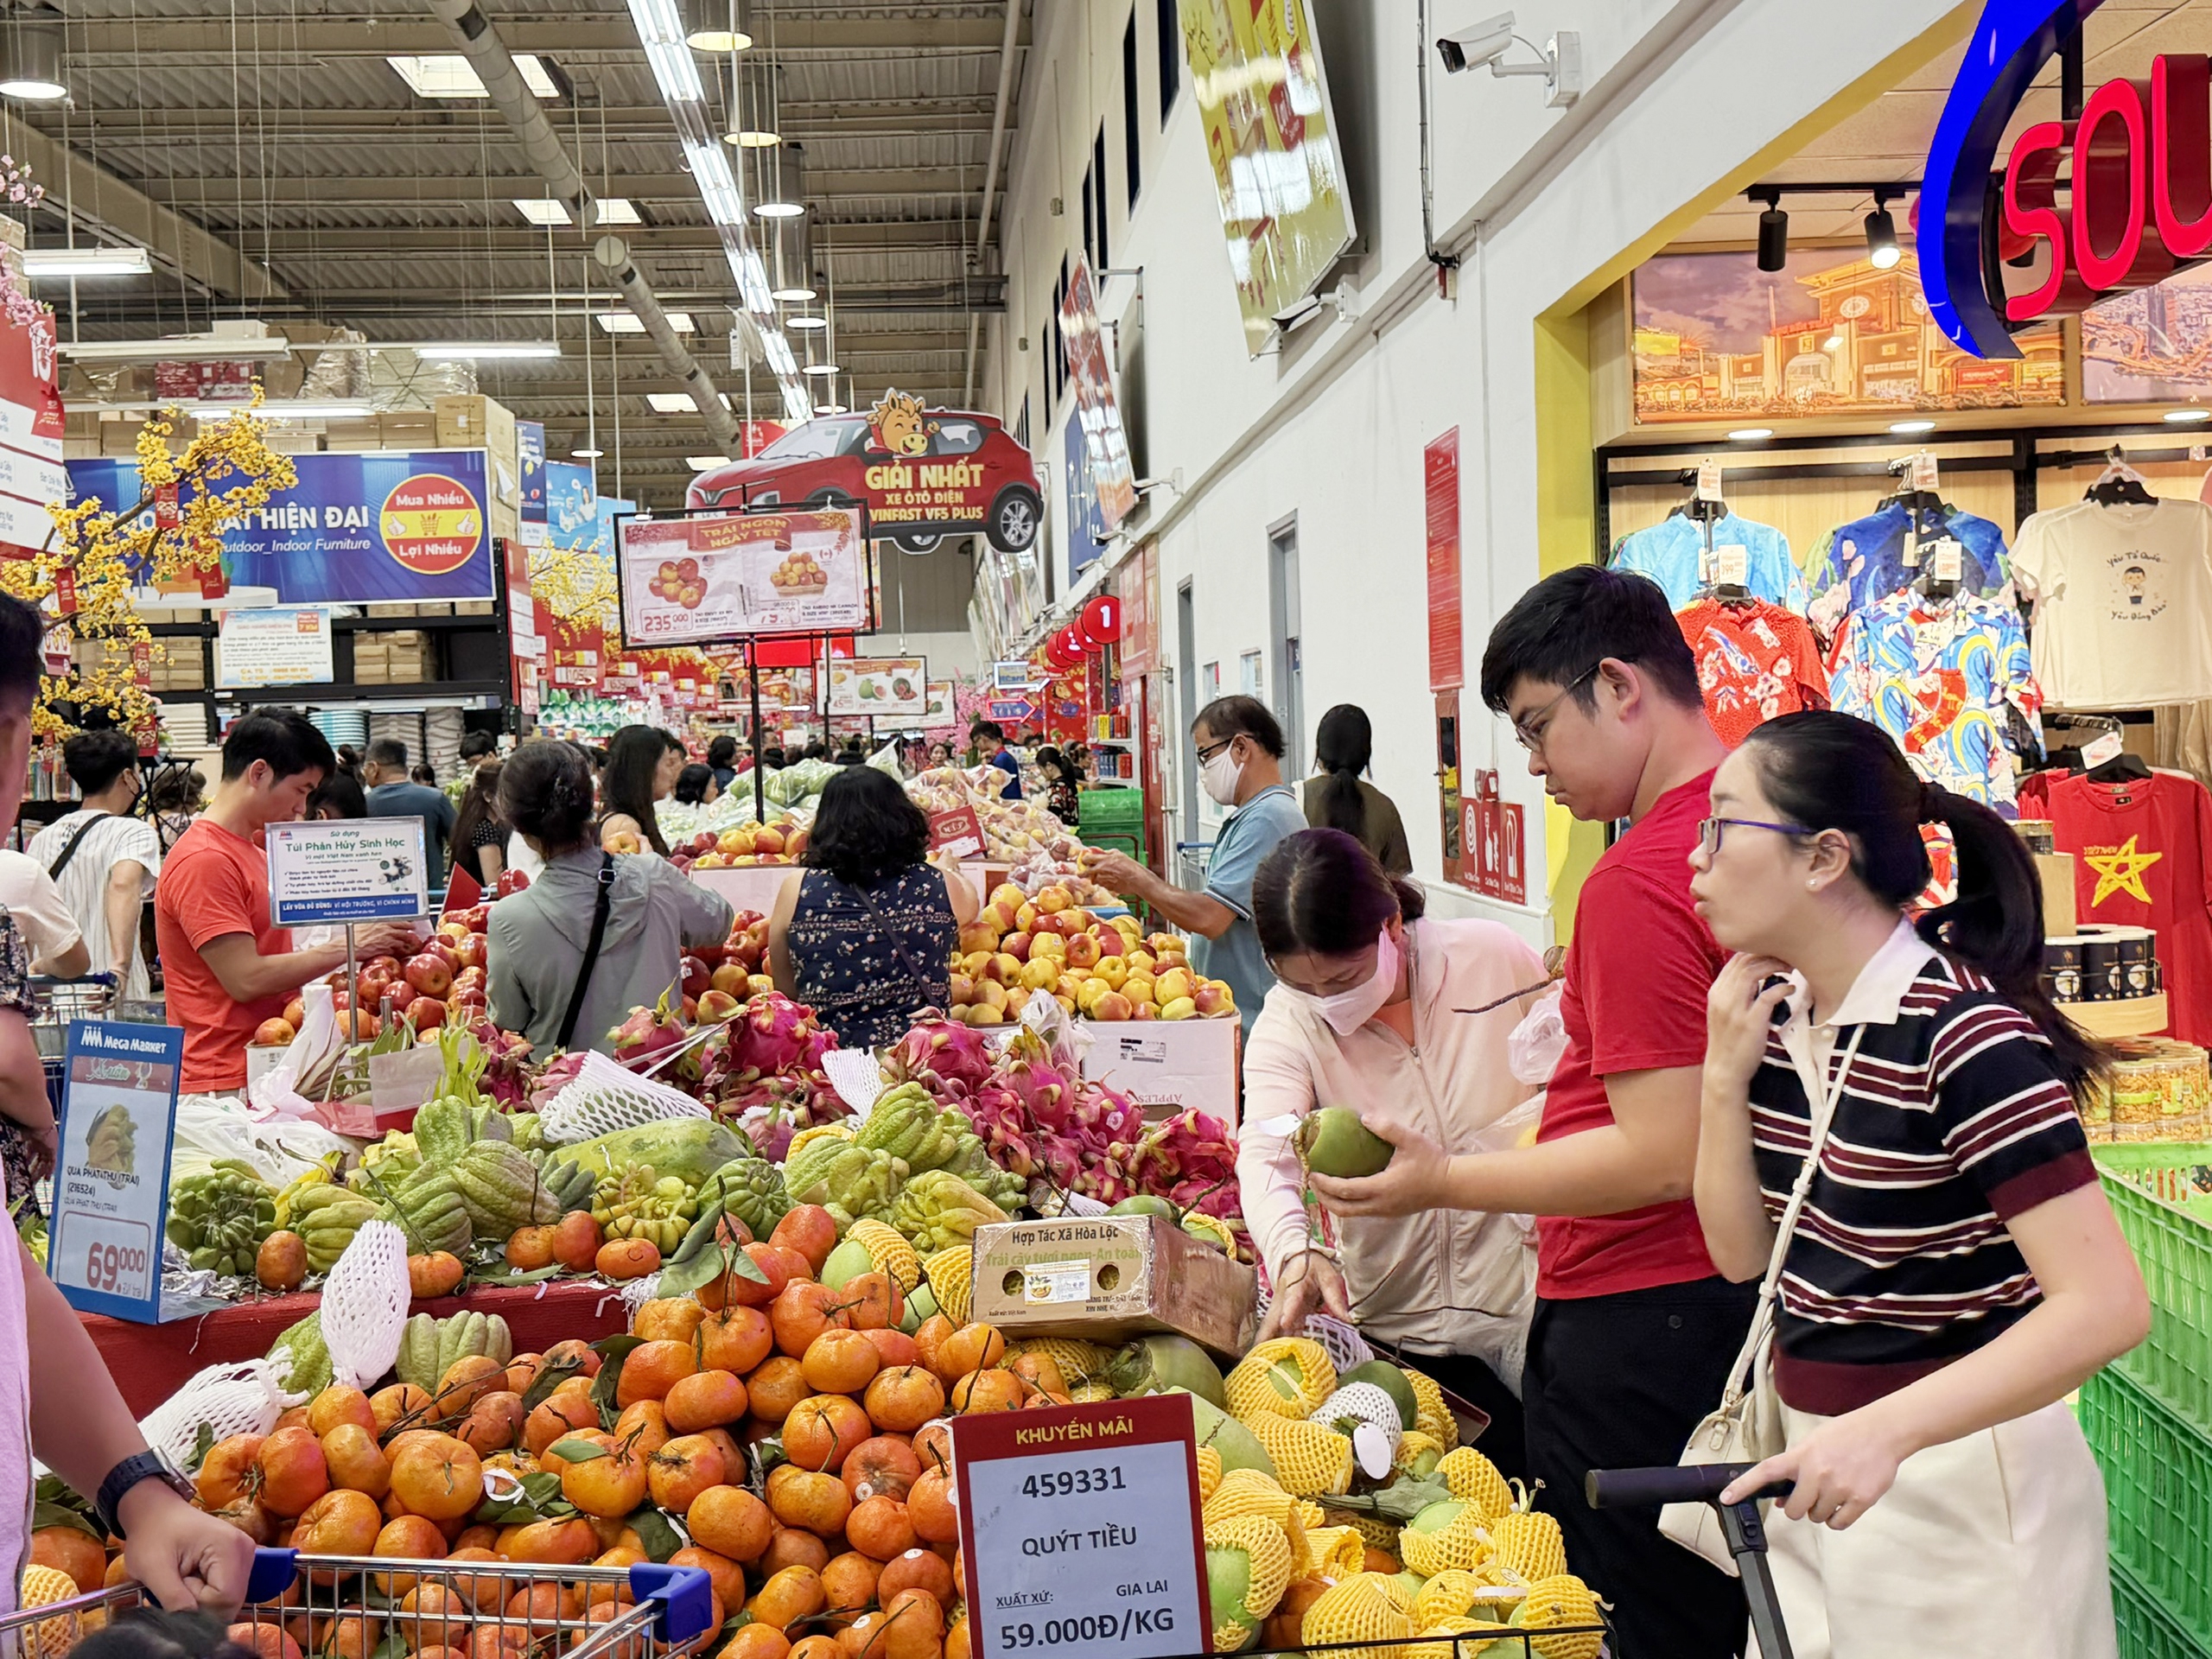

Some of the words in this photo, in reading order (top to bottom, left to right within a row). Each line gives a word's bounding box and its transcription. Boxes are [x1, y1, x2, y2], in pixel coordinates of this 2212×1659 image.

[865, 460, 912, 490] GIẢI
[919, 456, 984, 488] NHẤT
[396, 493, 423, 507] Mua
[427, 490, 464, 505] Nhiều
[886, 493, 901, 505] XE
[934, 488, 964, 506] ĐIỆN
[261, 501, 317, 536] HIỆN
[325, 505, 369, 535] ĐẠI
[870, 507, 923, 522] VINFAST
[952, 506, 983, 520] PLUS
[398, 544, 422, 558] Lợi
[426, 540, 462, 555] Nhiều
[1100, 605, 1110, 628] 1
[286, 842, 302, 852] Túi
[359, 840, 382, 849] Sinh
[385, 838, 405, 850] Học
[1138, 1094, 1183, 1103] APPLES
[1012, 1231, 1034, 1246] Hợp
[1038, 1229, 1055, 1243] Tác
[1058, 1227, 1071, 1241] Xã
[1075, 1227, 1096, 1241] Hòa
[1100, 1225, 1118, 1242] Lộc
[986, 1252, 1008, 1267] Trái
[1015, 1417, 1093, 1445] KHUYẾN
[1098, 1415, 1133, 1436] MÃI
[1022, 1466, 1126, 1498] 459331
[1021, 1529, 1082, 1557] QUÝT
[1088, 1522, 1137, 1549] TIỀU
[1116, 1582, 1142, 1597] GIA
[1147, 1580, 1168, 1593] LAI
[995, 1592, 1028, 1607] XUẤT
[1031, 1591, 1054, 1605] XỨ:
[1001, 1608, 1174, 1649] 59.000Đ/KG
